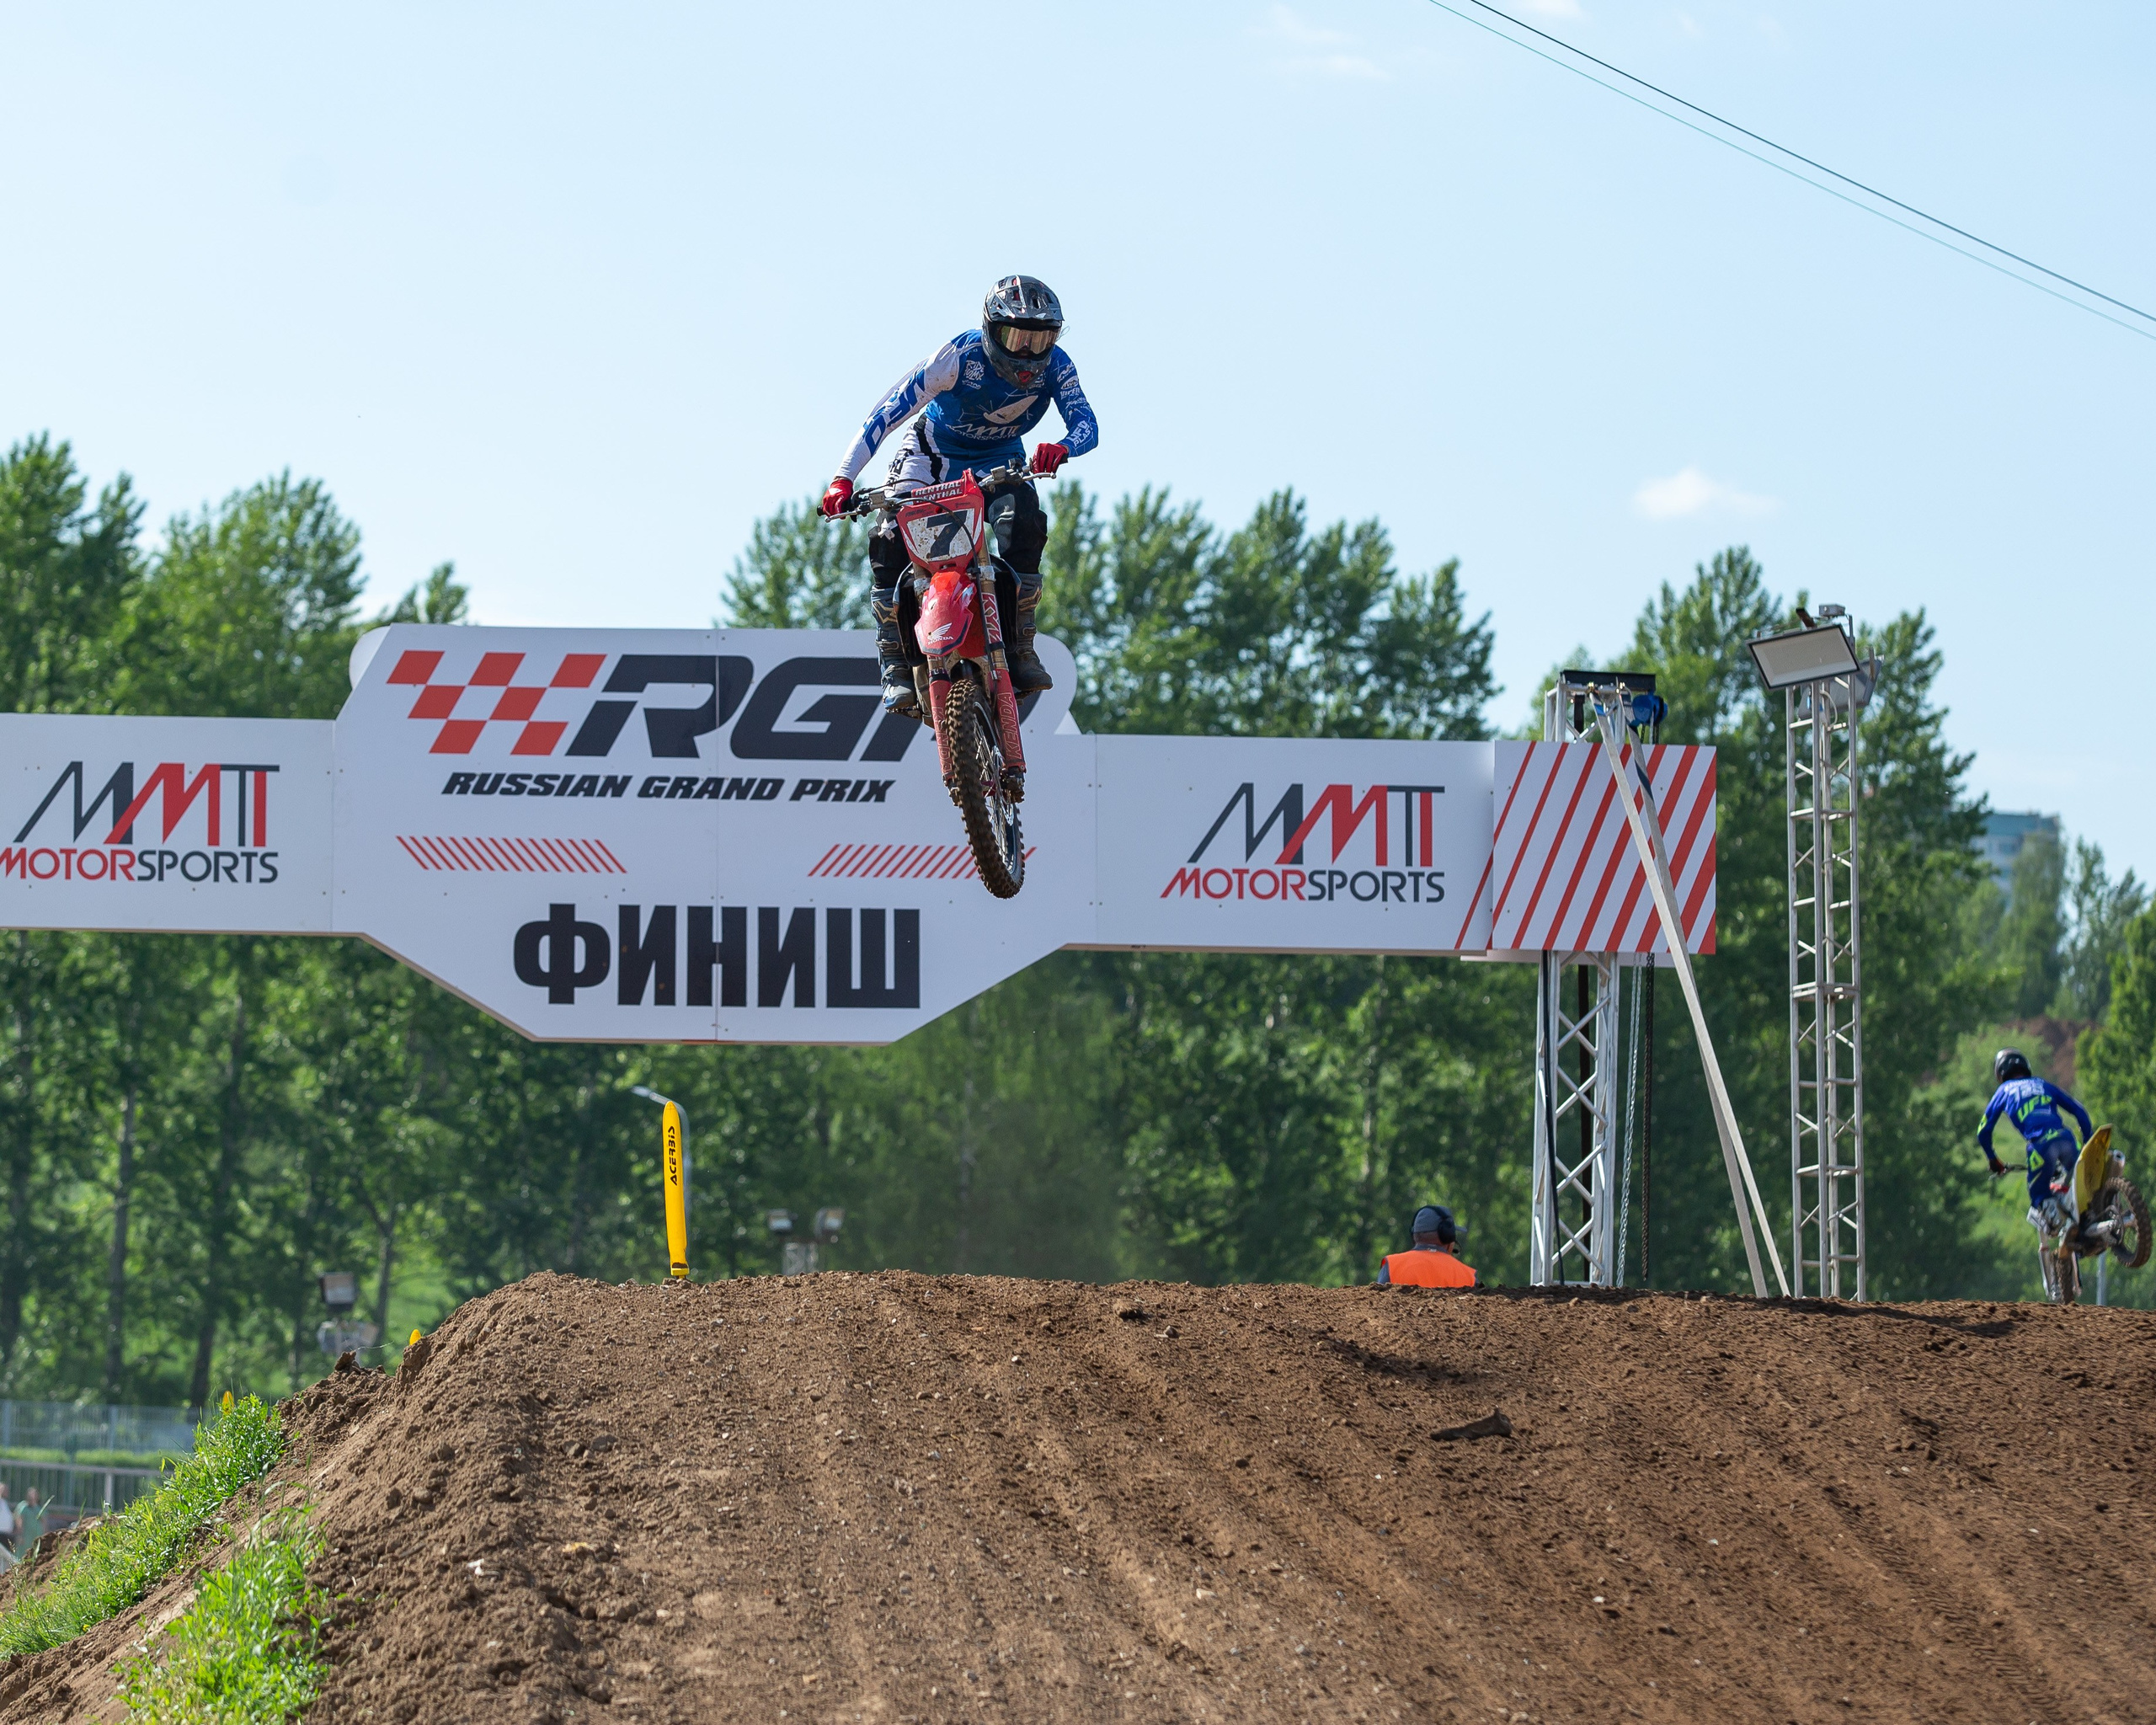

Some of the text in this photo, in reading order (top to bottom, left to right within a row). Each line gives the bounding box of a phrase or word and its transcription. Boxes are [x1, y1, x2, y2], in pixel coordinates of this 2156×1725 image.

[915, 481, 962, 496] RENTHAL
[926, 510, 968, 558] 7
[927, 635, 954, 645] HONDA
[997, 692, 1022, 760] KENDA
[441, 772, 897, 804] RUSSIAN GRAND PRIX
[0, 846, 279, 884] MOTORSPORTS
[1160, 868, 1446, 903] MOTORSPORTS
[514, 903, 921, 1009] ФИНИШ
[668, 1125, 678, 1186] ACERBIS
